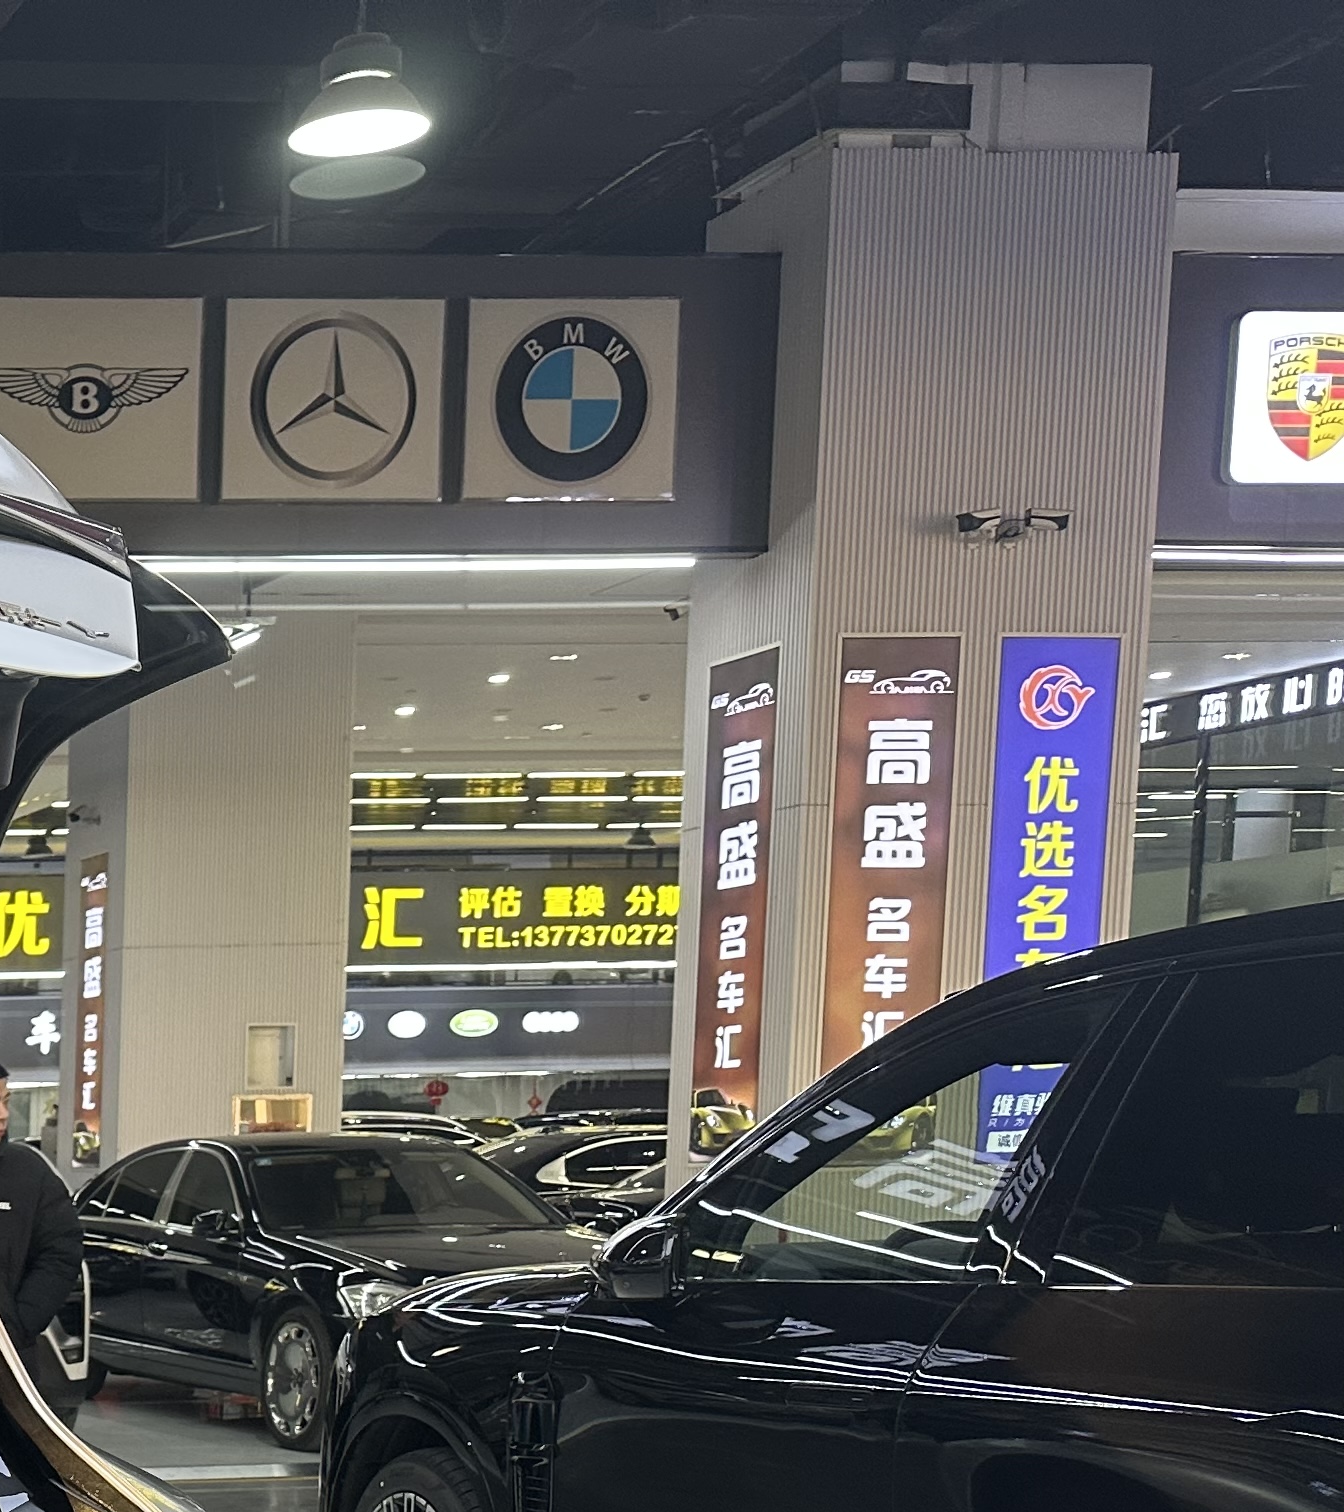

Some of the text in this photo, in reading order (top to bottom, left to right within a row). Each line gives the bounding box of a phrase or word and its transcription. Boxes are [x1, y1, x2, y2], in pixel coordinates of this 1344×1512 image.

[523, 322, 631, 366] BMW
[844, 669, 876, 685] GS
[458, 886, 523, 919] 评估
[542, 886, 606, 918] 置换
[457, 924, 679, 949] TEL:1377370272
